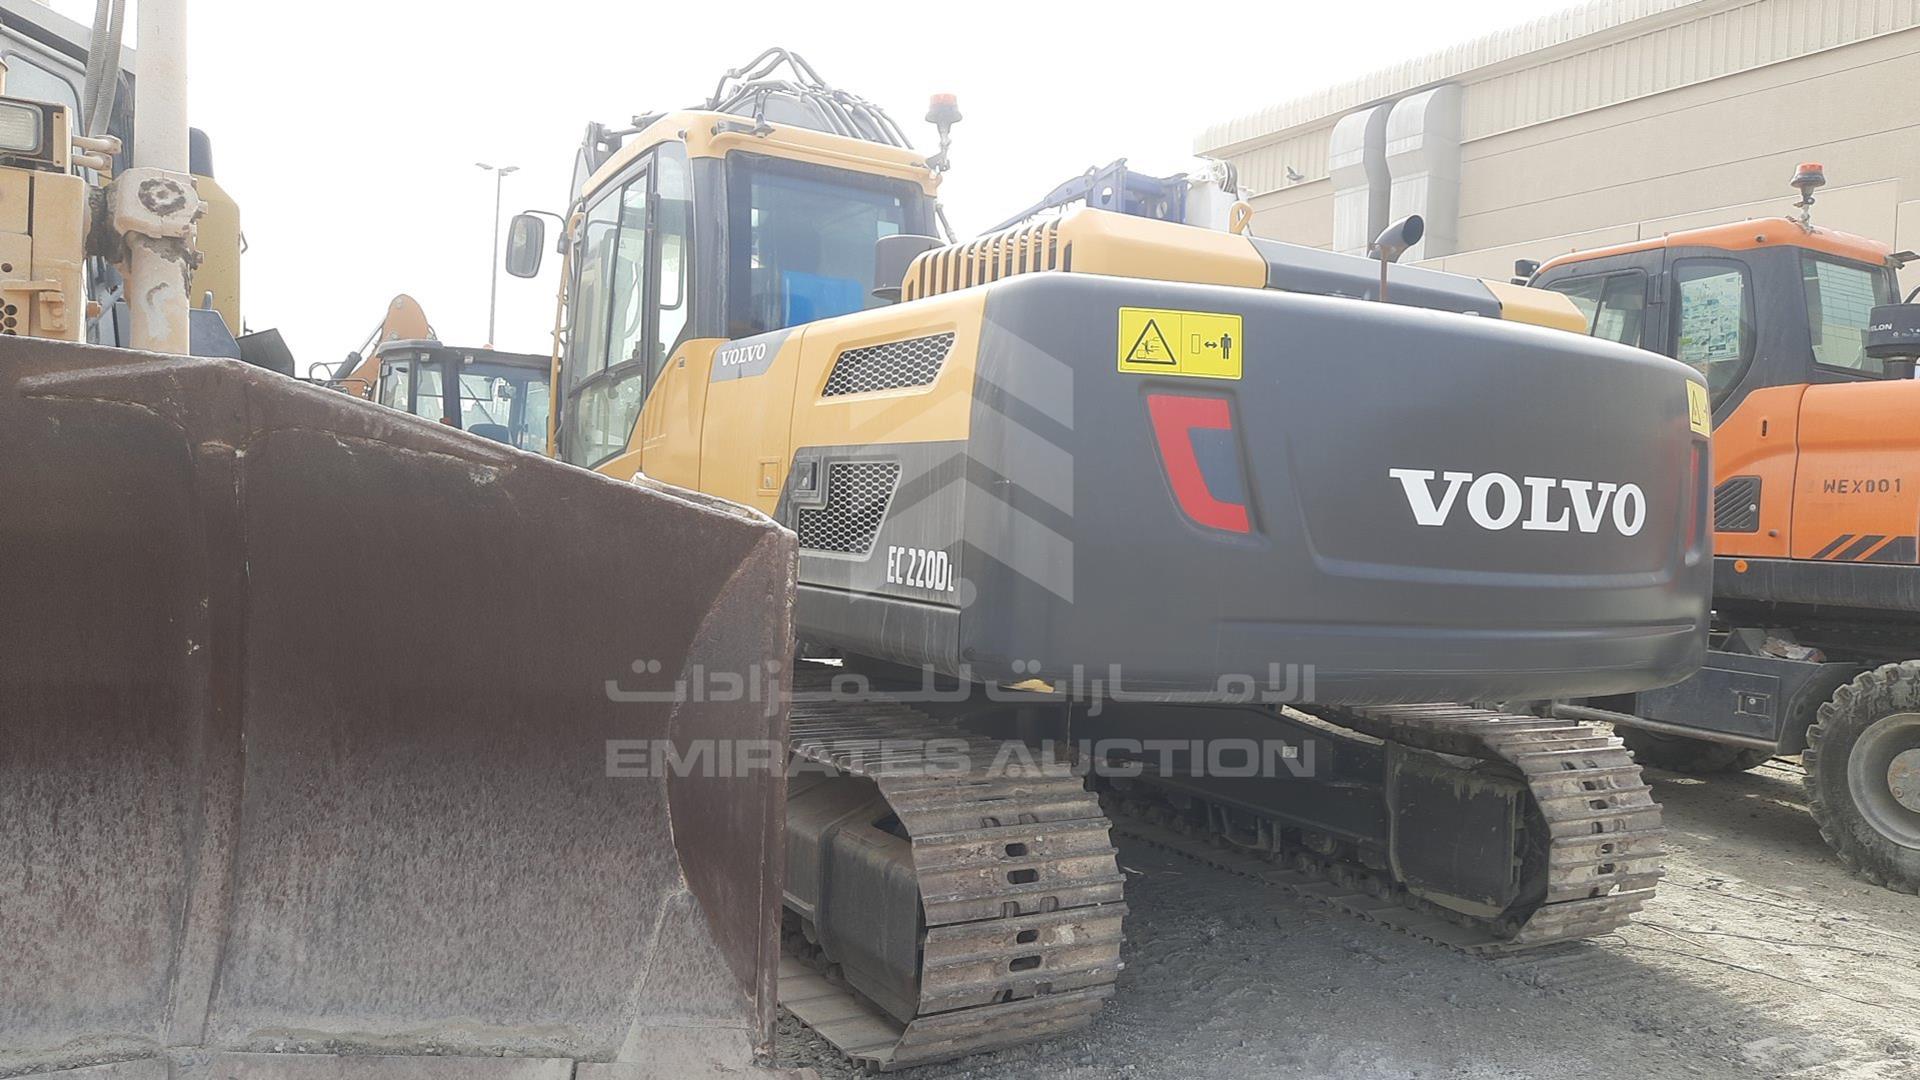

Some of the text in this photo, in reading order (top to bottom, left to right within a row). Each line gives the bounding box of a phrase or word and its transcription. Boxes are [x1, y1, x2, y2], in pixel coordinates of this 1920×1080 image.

[721, 343, 767, 367] VOLVO
[1389, 467, 1647, 537] VOLVO
[1823, 478, 1901, 494] WEX001
[887, 545, 905, 585] EC
